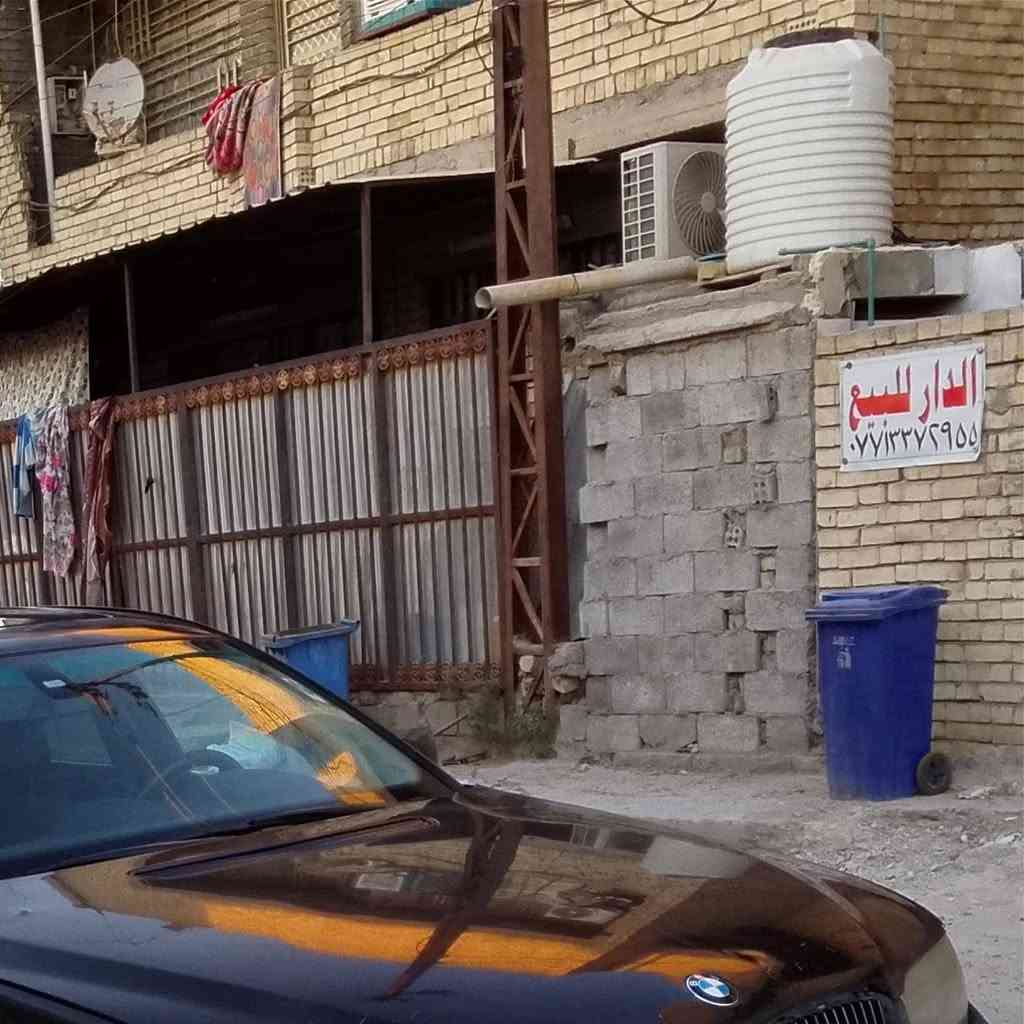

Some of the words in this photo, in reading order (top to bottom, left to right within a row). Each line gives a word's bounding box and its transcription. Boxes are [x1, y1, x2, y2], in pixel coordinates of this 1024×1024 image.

[849, 363, 911, 431] للبيع
[918, 355, 977, 424] الدار
[850, 421, 977, 457] ٠٧٧١٣٣٧٢٩٥٥
